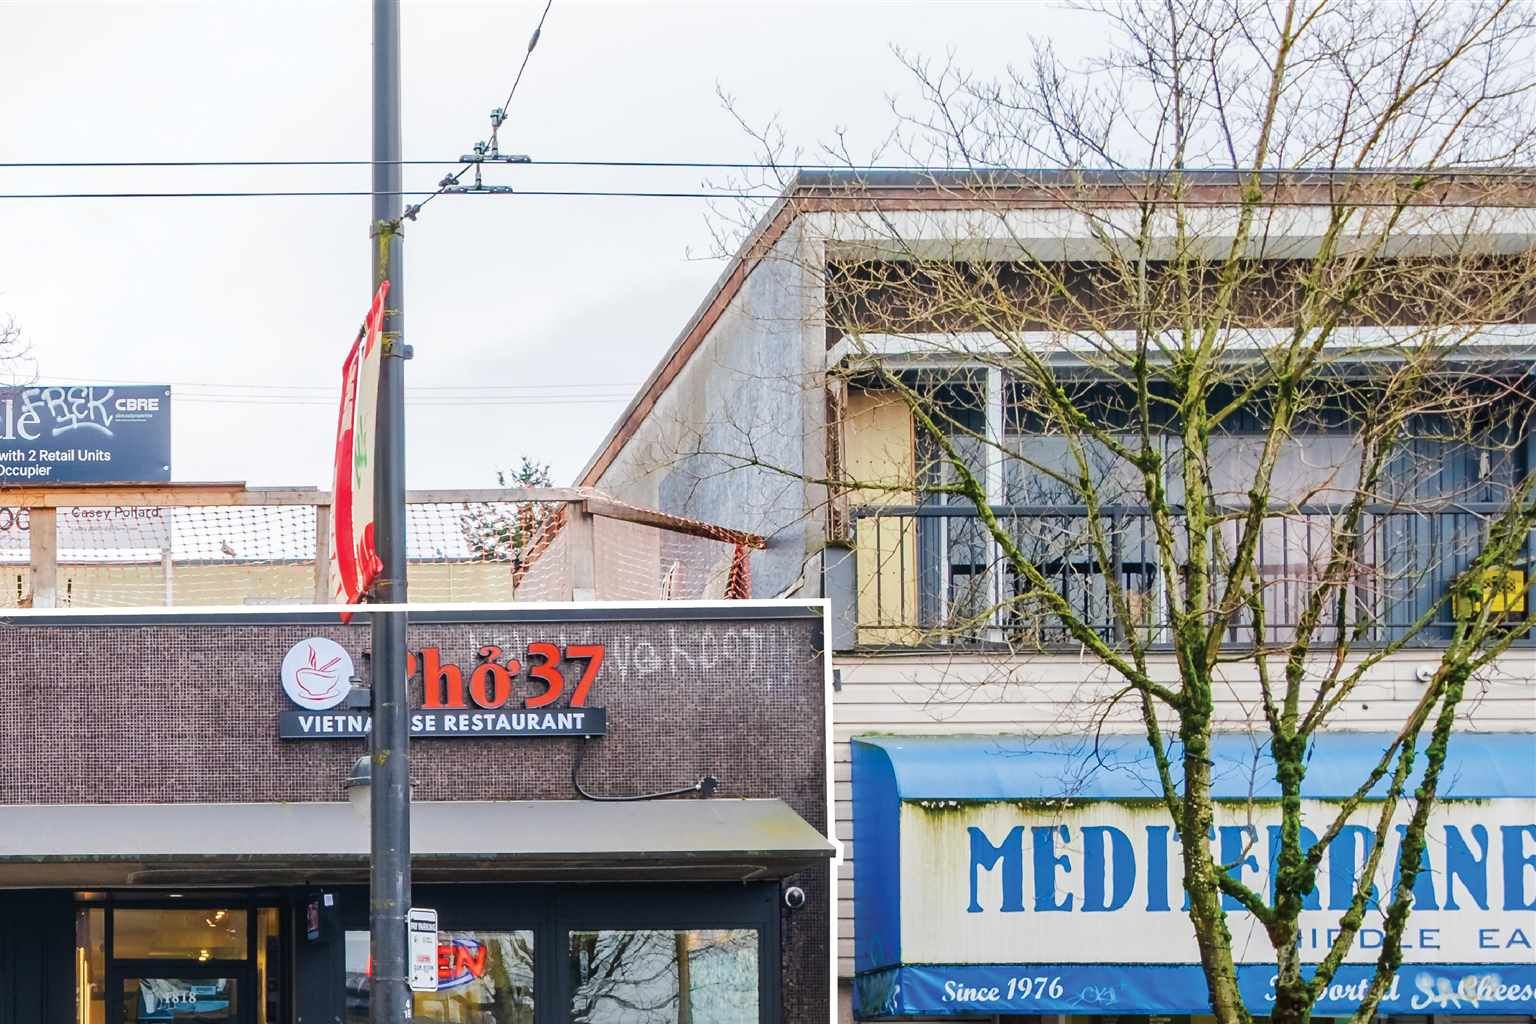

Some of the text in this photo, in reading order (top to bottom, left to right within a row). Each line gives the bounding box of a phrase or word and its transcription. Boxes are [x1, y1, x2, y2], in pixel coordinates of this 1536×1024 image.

[115, 398, 160, 411] CBRE
[28, 450, 37, 462] 2
[39, 450, 75, 462] Retail
[77, 450, 112, 462] Units
[71, 506, 111, 520] Casey
[362, 645, 521, 709] hở
[298, 713, 585, 732] VIETNSE RESTAURANT
[967, 825, 1536, 912] MEDIERRANE
[942, 980, 1000, 1002] Since
[1007, 976, 1064, 1000] 1976
